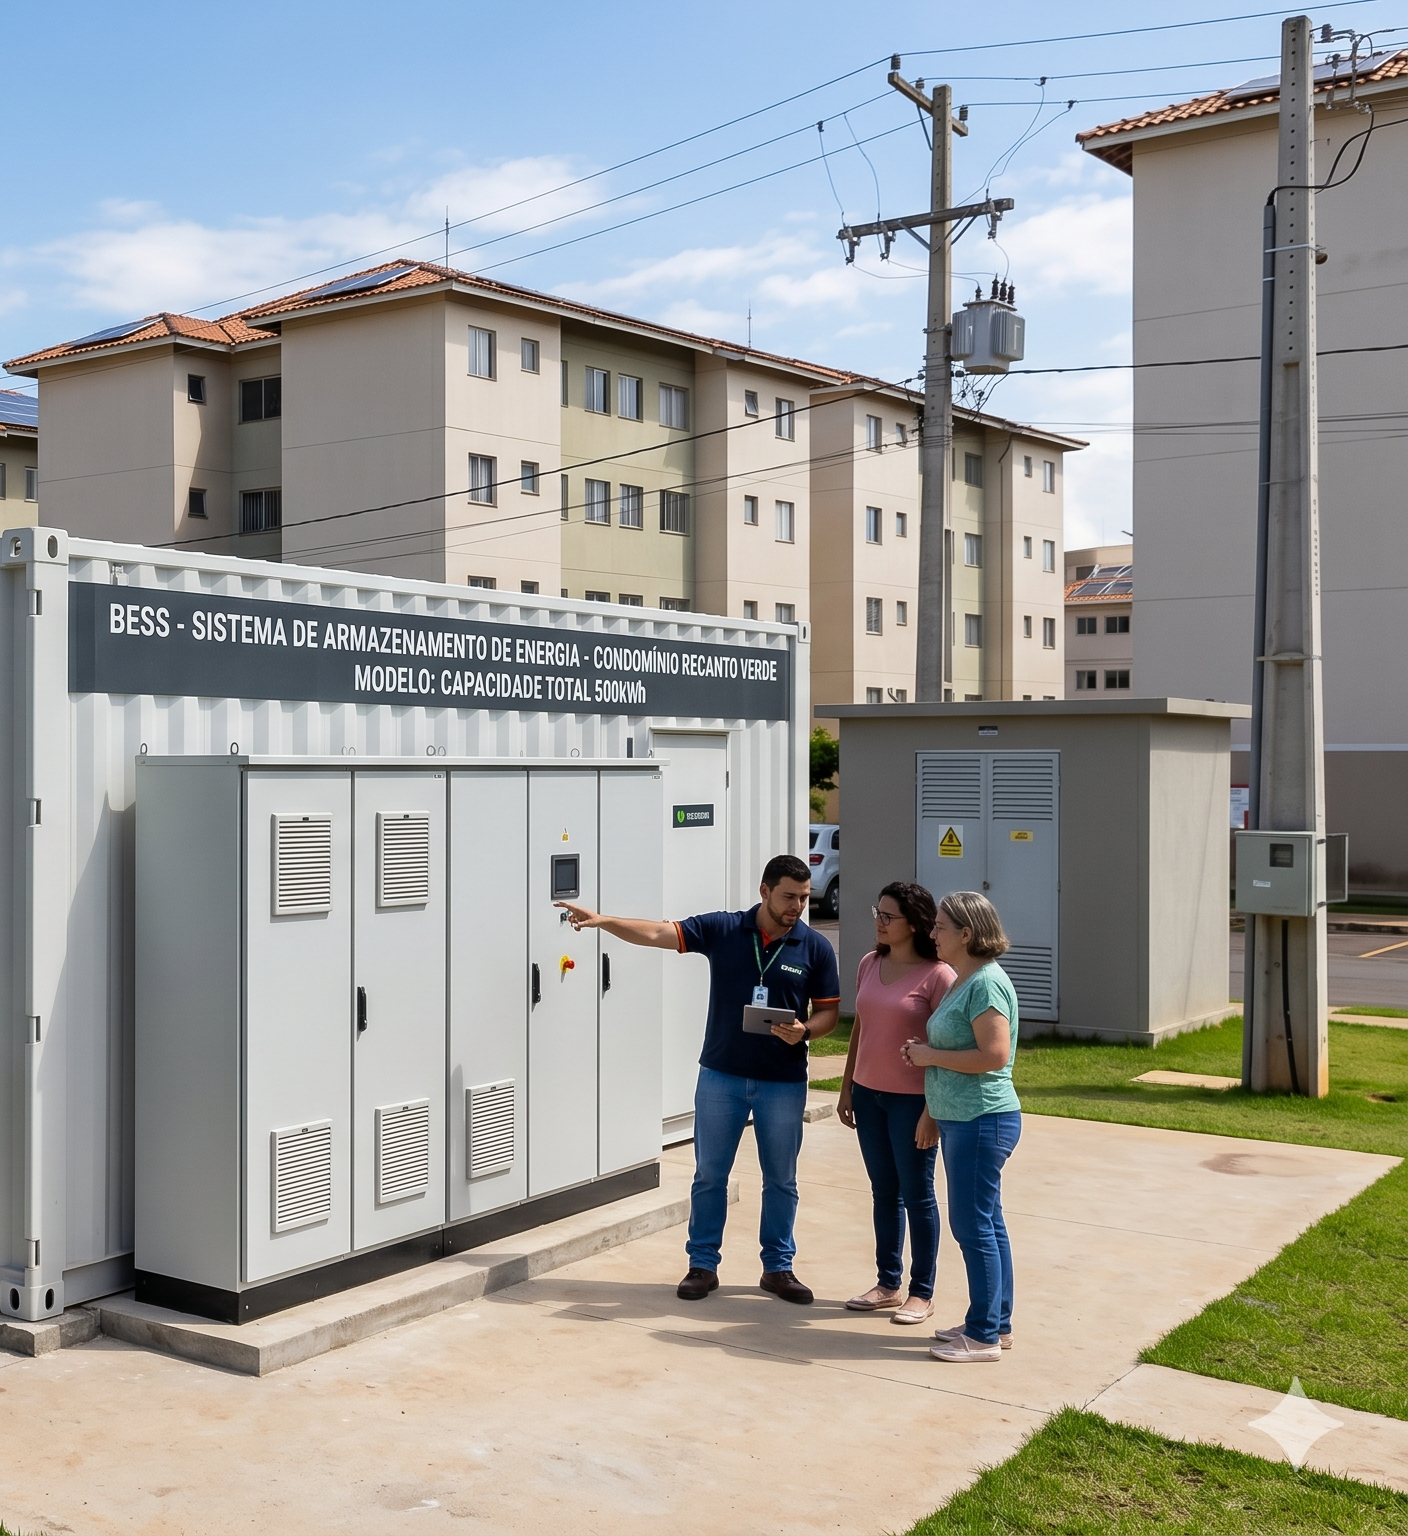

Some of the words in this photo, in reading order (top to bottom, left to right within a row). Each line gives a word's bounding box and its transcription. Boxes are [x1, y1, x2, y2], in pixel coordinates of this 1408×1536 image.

[110, 602, 170, 638] BESS
[191, 610, 288, 647] SISTEMA
[293, 619, 319, 649] DE
[322, 622, 487, 661] ARMAZENAMENTO
[491, 636, 512, 663] DE
[515, 638, 581, 668] ENERGIA
[593, 645, 679, 675] CONDOMÍNIO
[681, 653, 738, 679] RECANTO
[739, 657, 777, 682] VERDE
[354, 664, 436, 694] MODELO:
[440, 669, 543, 700] CAPACIDADE
[545, 675, 592, 702] TOTAL
